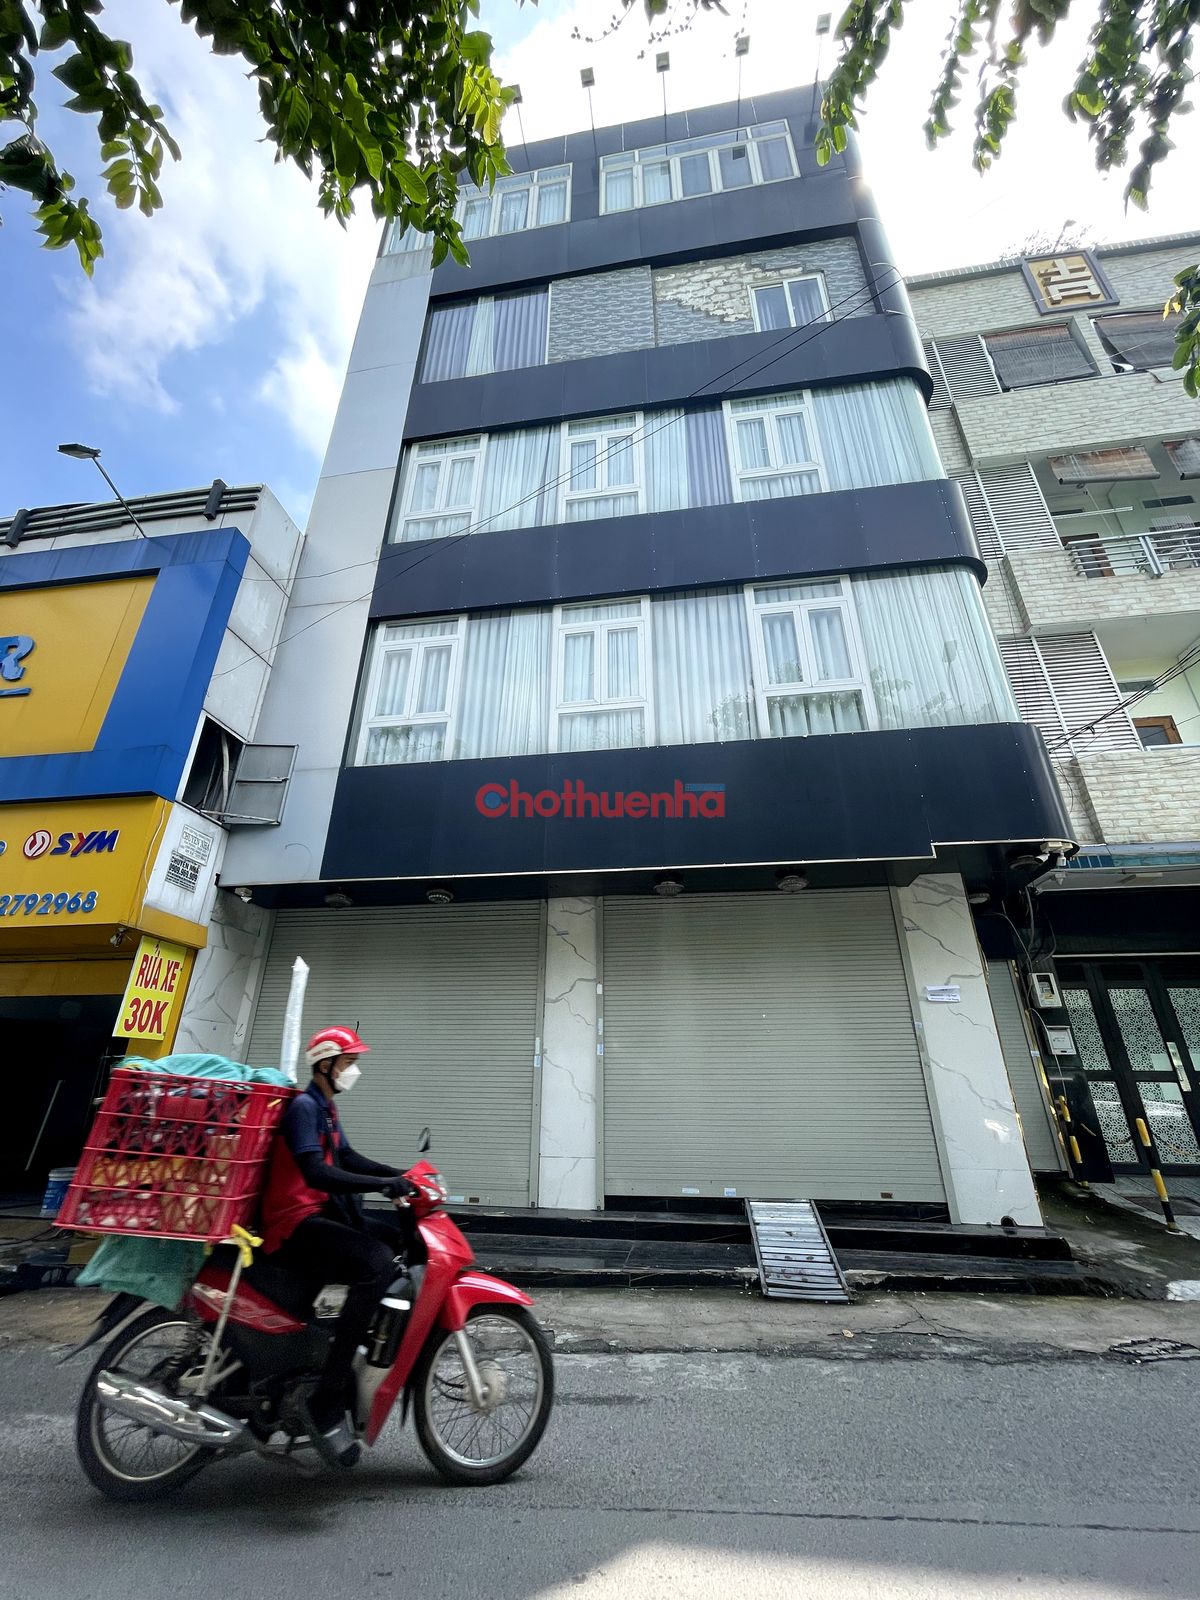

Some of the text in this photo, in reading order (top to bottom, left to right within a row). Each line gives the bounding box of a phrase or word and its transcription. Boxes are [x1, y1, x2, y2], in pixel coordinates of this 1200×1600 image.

[50, 830, 120, 857] SYM
[160, 959, 180, 993] XE
[124, 997, 169, 1034] 30K
